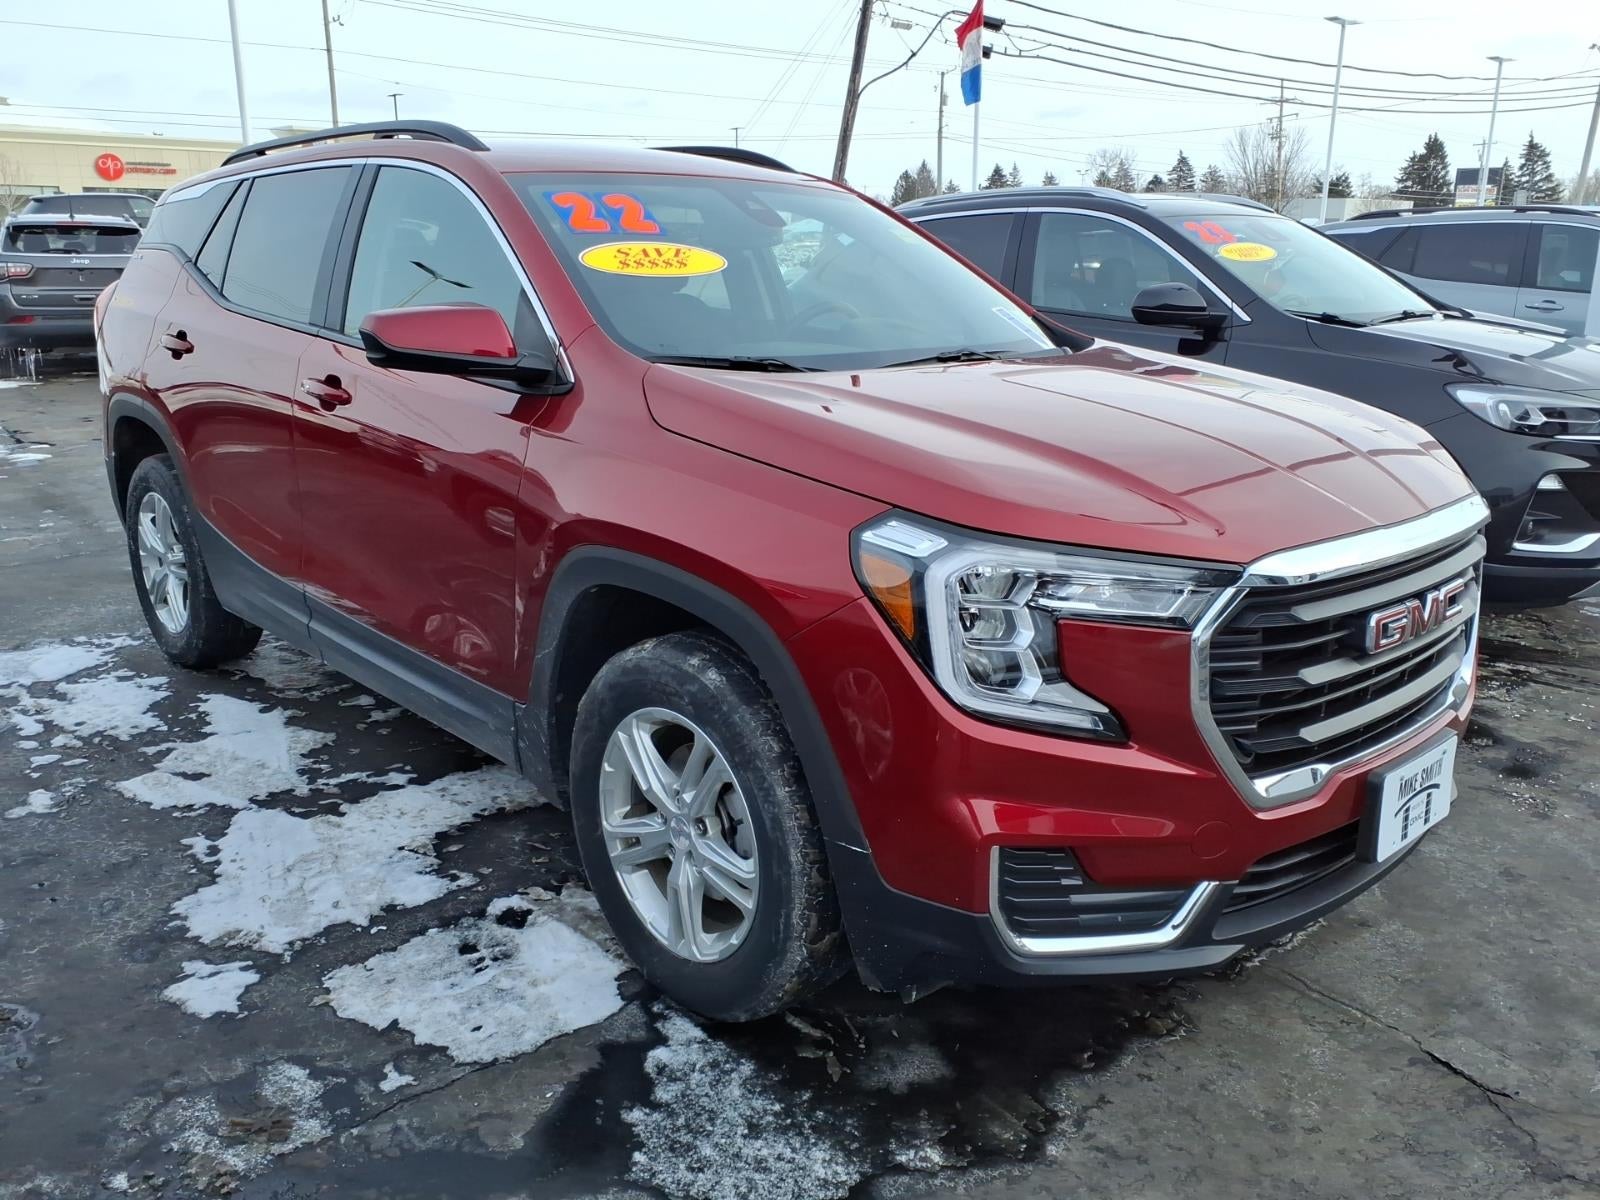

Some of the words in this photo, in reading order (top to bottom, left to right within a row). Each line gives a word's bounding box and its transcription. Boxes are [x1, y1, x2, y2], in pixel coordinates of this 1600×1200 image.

[551, 191, 660, 234] 22
[614, 247, 692, 259] SAVE
[617, 258, 688, 270] $$$$$
[1366, 578, 1465, 655] GMC
[1398, 771, 1419, 801] MIKE
[1420, 757, 1444, 787] SMITH
